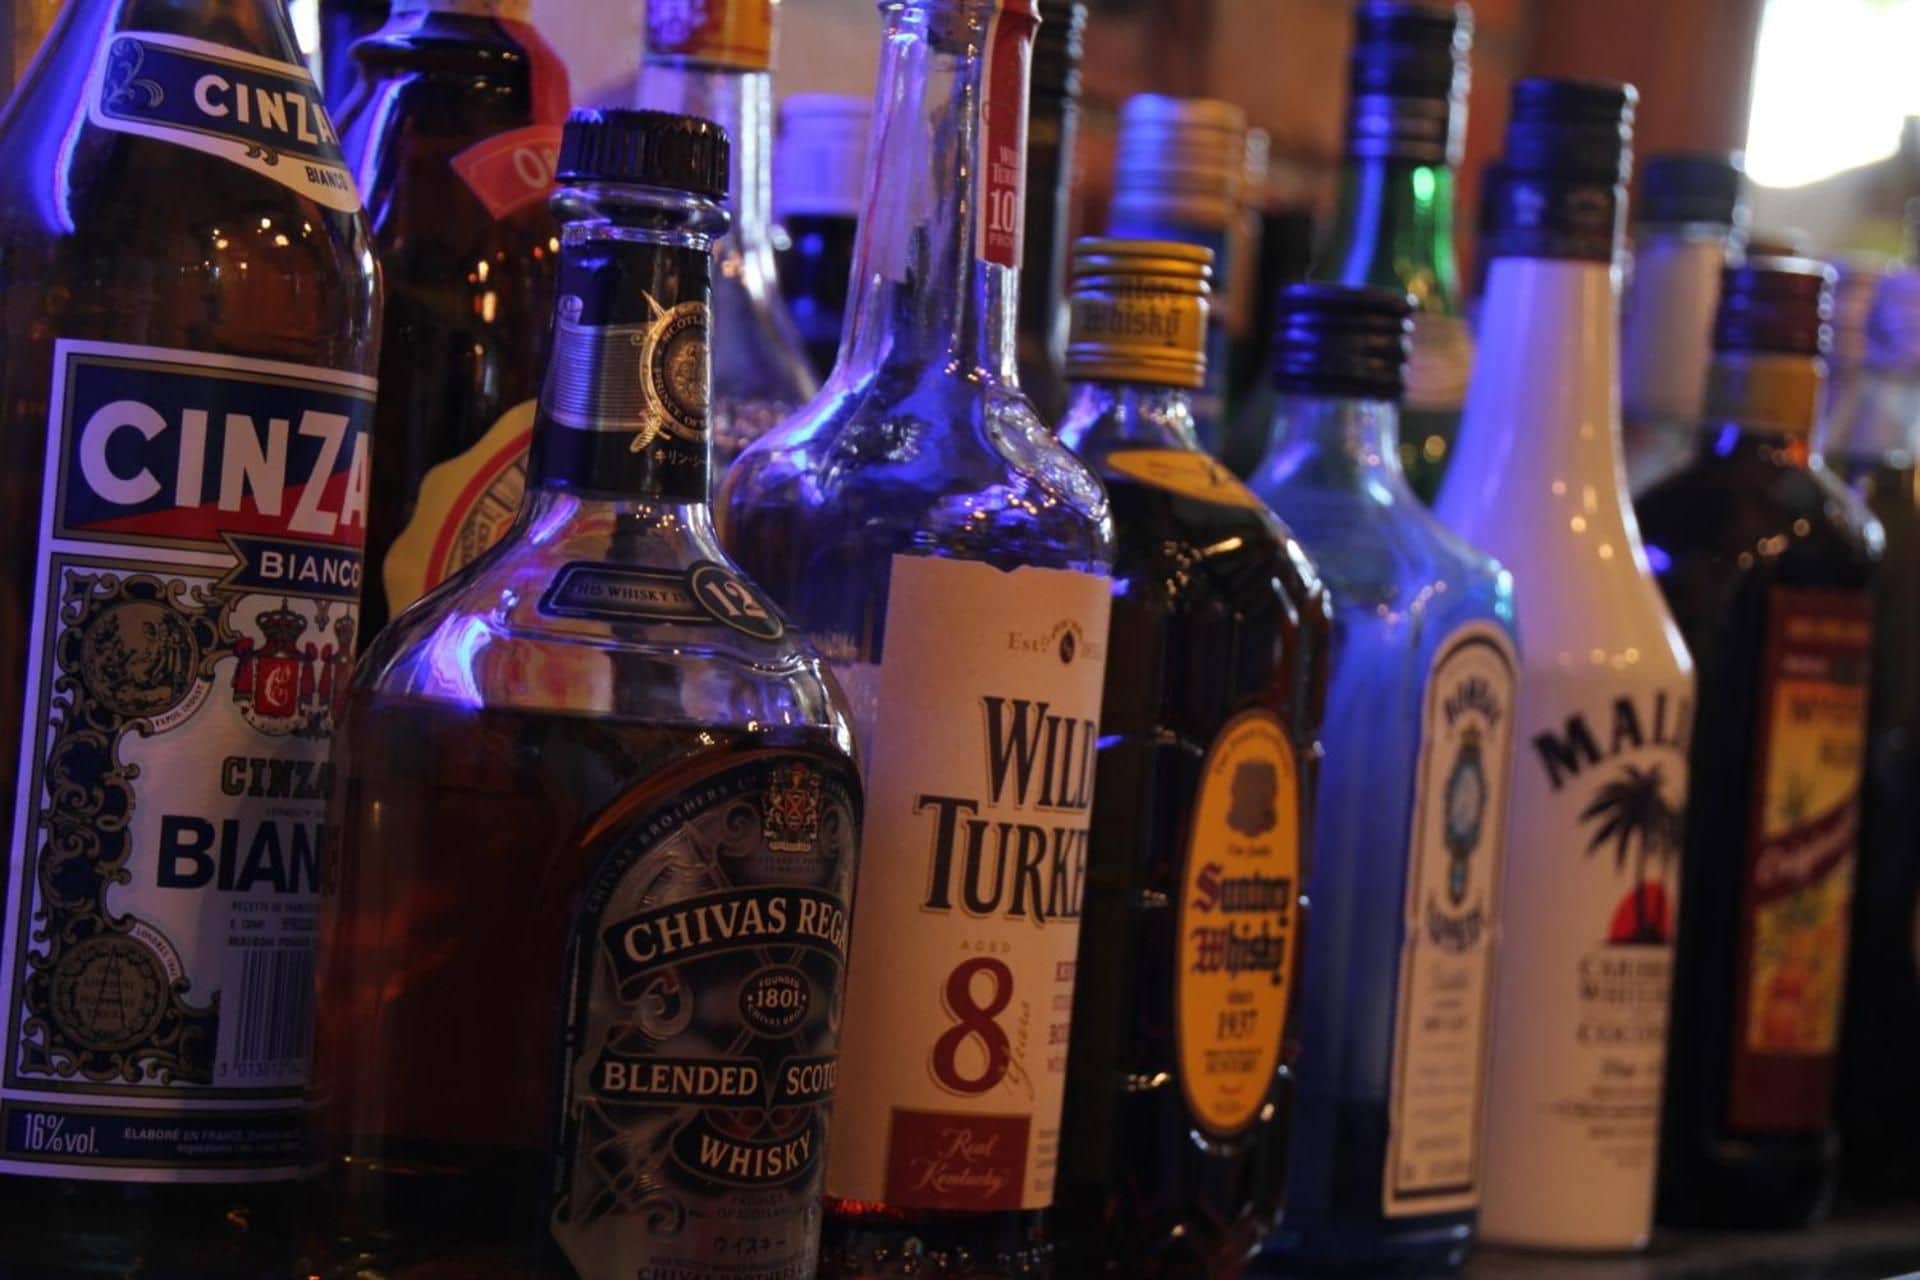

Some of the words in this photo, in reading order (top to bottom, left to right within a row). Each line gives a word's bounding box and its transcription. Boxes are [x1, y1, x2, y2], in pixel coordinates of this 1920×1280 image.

[259, 551, 361, 588] BIANCO
[607, 583, 668, 602] WHISKY
[705, 580, 769, 619] 12
[622, 896, 788, 963] CHIVAS
[960, 940, 1012, 953] AGED
[757, 987, 799, 1008] 1801
[928, 956, 1014, 1097] 8
[602, 1060, 759, 1096] BLENDED
[699, 1128, 812, 1178] WHISKY
